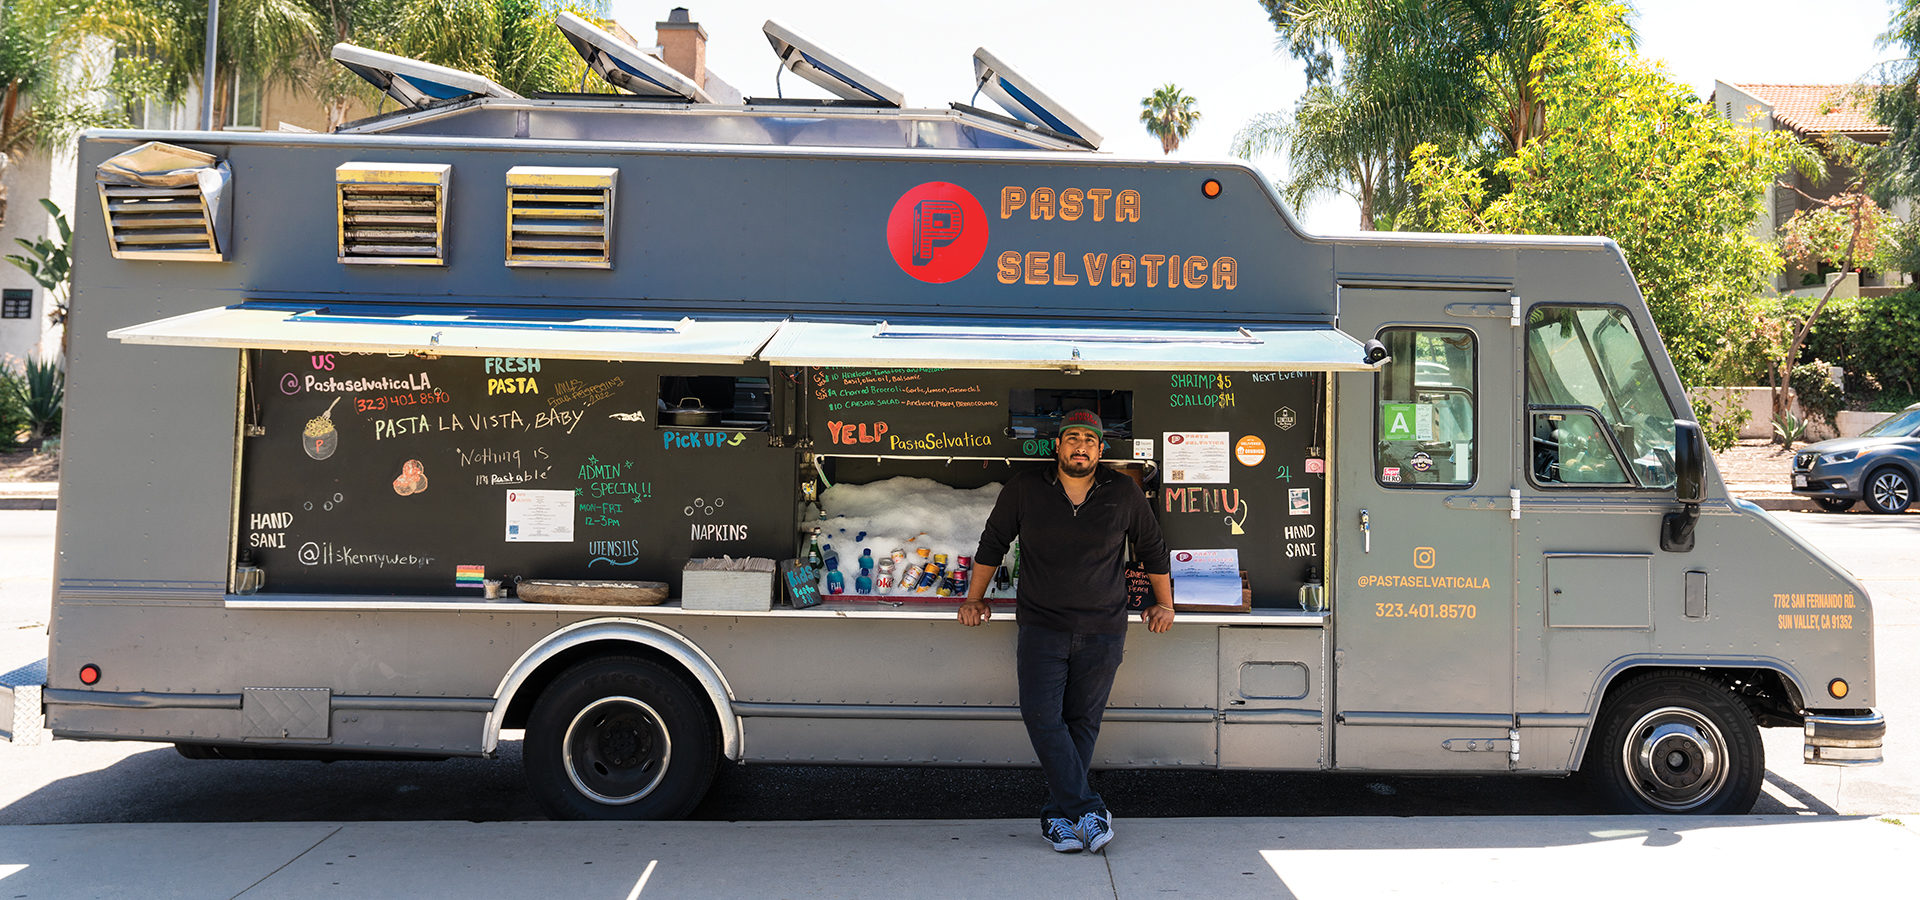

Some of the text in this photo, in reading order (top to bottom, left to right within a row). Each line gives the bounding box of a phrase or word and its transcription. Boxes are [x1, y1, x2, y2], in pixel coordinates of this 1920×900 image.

[1000, 186, 1141, 223] PASTA
[997, 250, 1238, 290] SELVATICA
[312, 353, 335, 371] US
[485, 357, 541, 374] FRESH
[1252, 372, 1276, 382] NEXT
[487, 377, 539, 396] PASTA
[354, 396, 388, 414] (323)
[391, 393, 416, 406] 401
[439, 414, 464, 431] LA
[1390, 412, 1410, 433] A
[705, 431, 727, 447] UP
[827, 420, 992, 451] YELP PastaSelvatica
[578, 463, 620, 480] ADMIN
[1166, 487, 1239, 513] MENU
[251, 512, 293, 530] HAND
[250, 532, 286, 548] SANI
[691, 524, 748, 541] NAPKINS
[1284, 524, 1316, 540] HAND
[589, 539, 639, 557] UTENSILS
[1285, 542, 1317, 557] SANI
[1357, 575, 1491, 589] @PASTASELVATICALA
[1773, 593, 1856, 608] 7782 SAN FERNANDO RD.
[1375, 602, 1477, 619] 323.401.8570
[1778, 614, 1853, 631] SUN VALLEY, CA 91352
